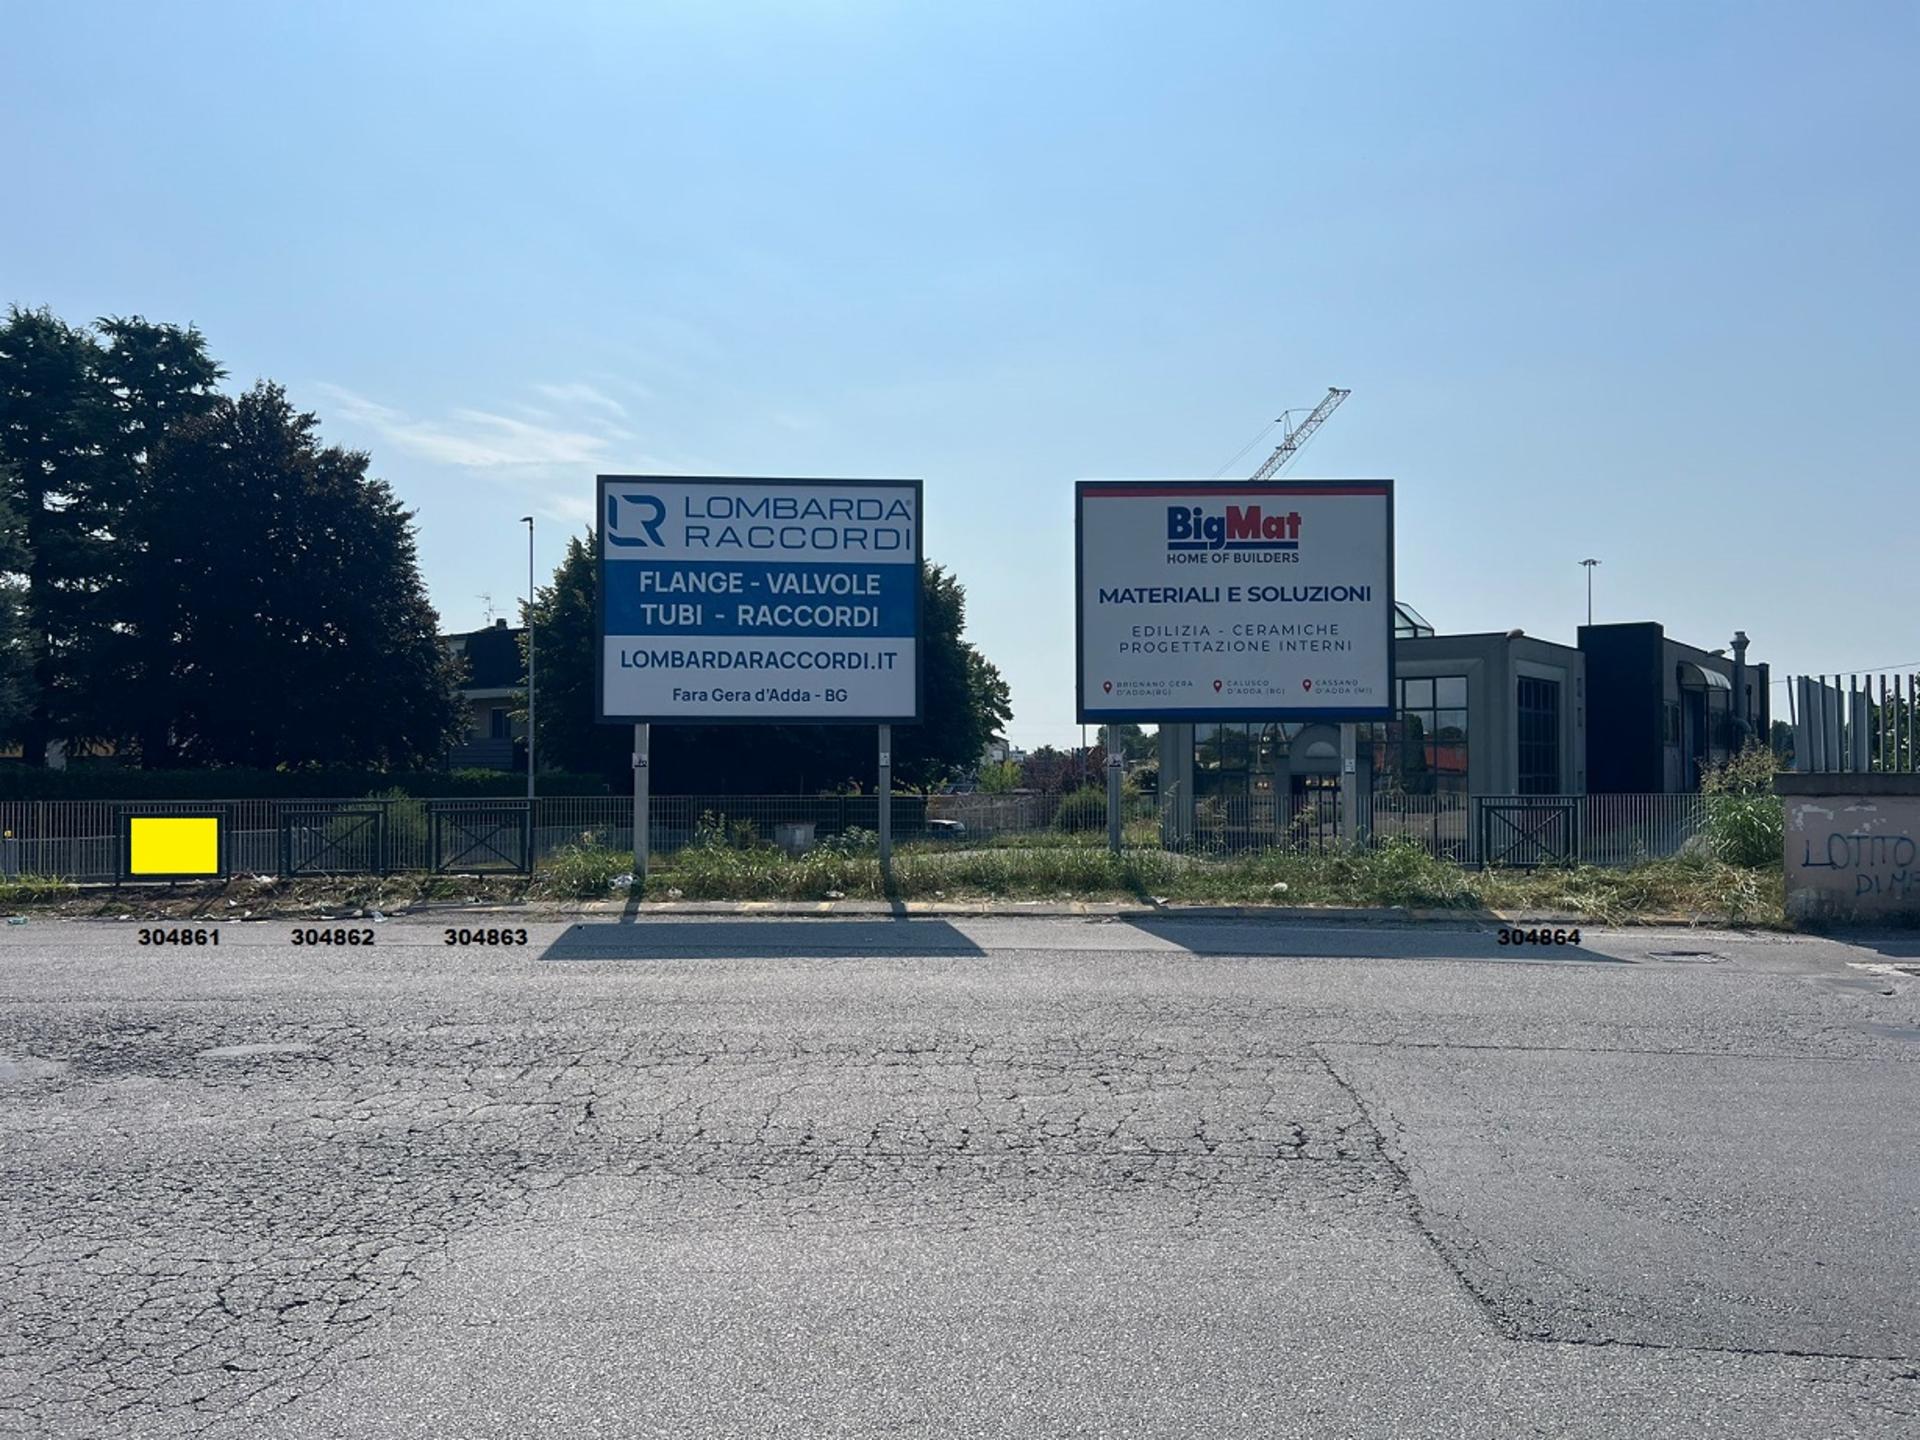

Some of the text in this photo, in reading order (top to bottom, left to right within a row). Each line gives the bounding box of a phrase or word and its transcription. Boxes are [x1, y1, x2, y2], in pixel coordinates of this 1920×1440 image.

[685, 496, 912, 521] LOMBARDA
[685, 525, 911, 550] RACCORDI
[1167, 505, 1302, 550] BigMat
[1167, 553, 1299, 564] HOME OF BUILDERS
[639, 571, 744, 593] FLANGE
[766, 573, 881, 595] VALVOLE
[1099, 586, 1371, 603] MATERIALI E SOLUZIONI
[640, 604, 702, 625] TUBI
[738, 605, 879, 627] RACCORDI
[1132, 626, 1211, 637] EDILIZIA
[1232, 624, 1339, 636] CERAMICHE
[1120, 640, 1351, 653] PROGETTAZIONE INTERNI
[621, 650, 897, 670] LOMBARDARACCORDI.IT
[673, 688, 708, 702] Fara
[712, 689, 751, 702] Gera
[755, 689, 811, 702] d'Adda
[825, 690, 848, 702] BG
[1802, 833, 1916, 870] LOTTO
[1856, 873, 1881, 896] DI
